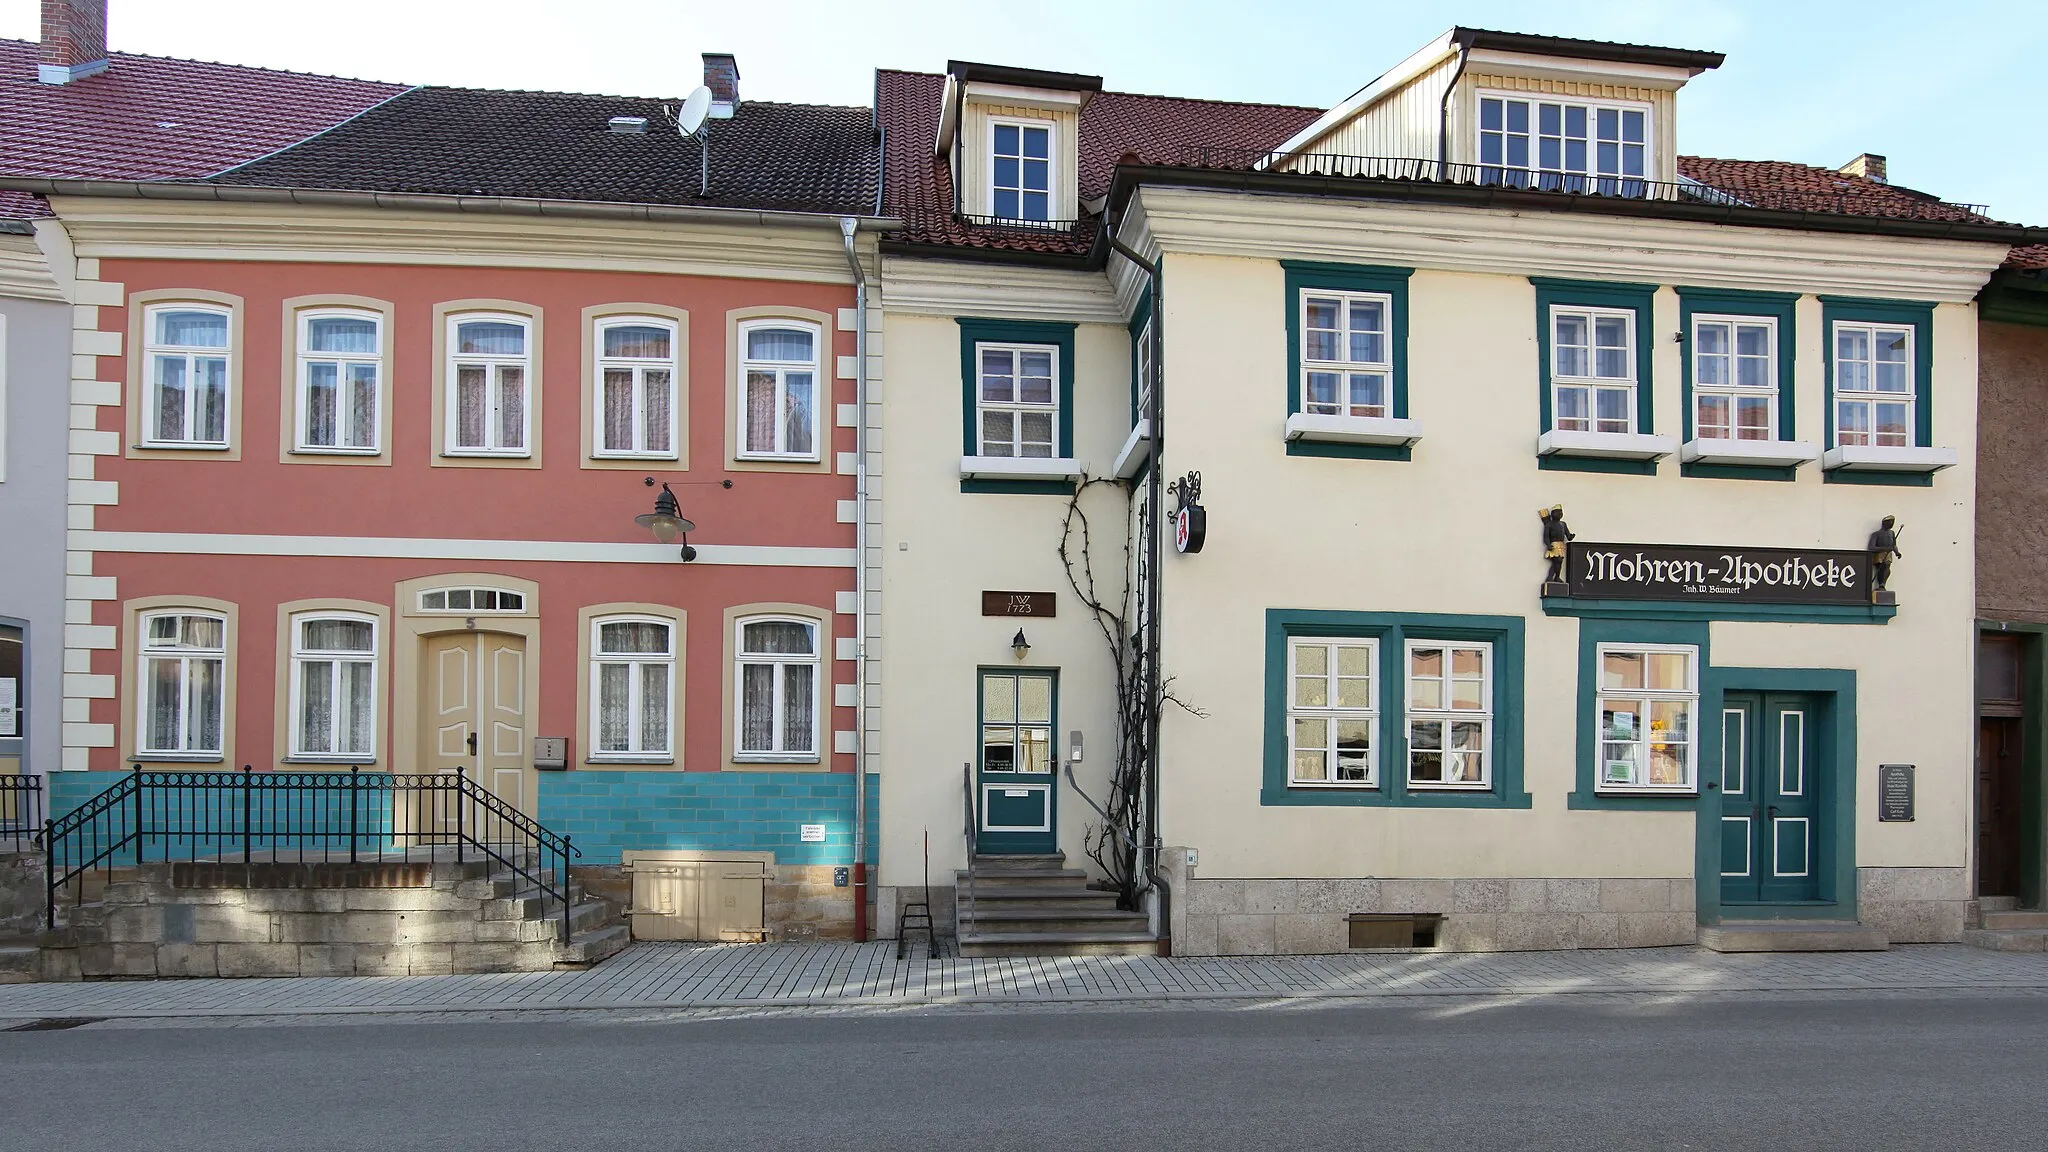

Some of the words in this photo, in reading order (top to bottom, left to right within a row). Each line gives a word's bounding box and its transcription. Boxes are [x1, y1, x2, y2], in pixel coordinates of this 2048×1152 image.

[1585, 550, 1856, 590] Mohren-Apotheke
[1709, 584, 1741, 594] Bäumert
[1007, 603, 1032, 613] 1723
[467, 617, 475, 629] 5
